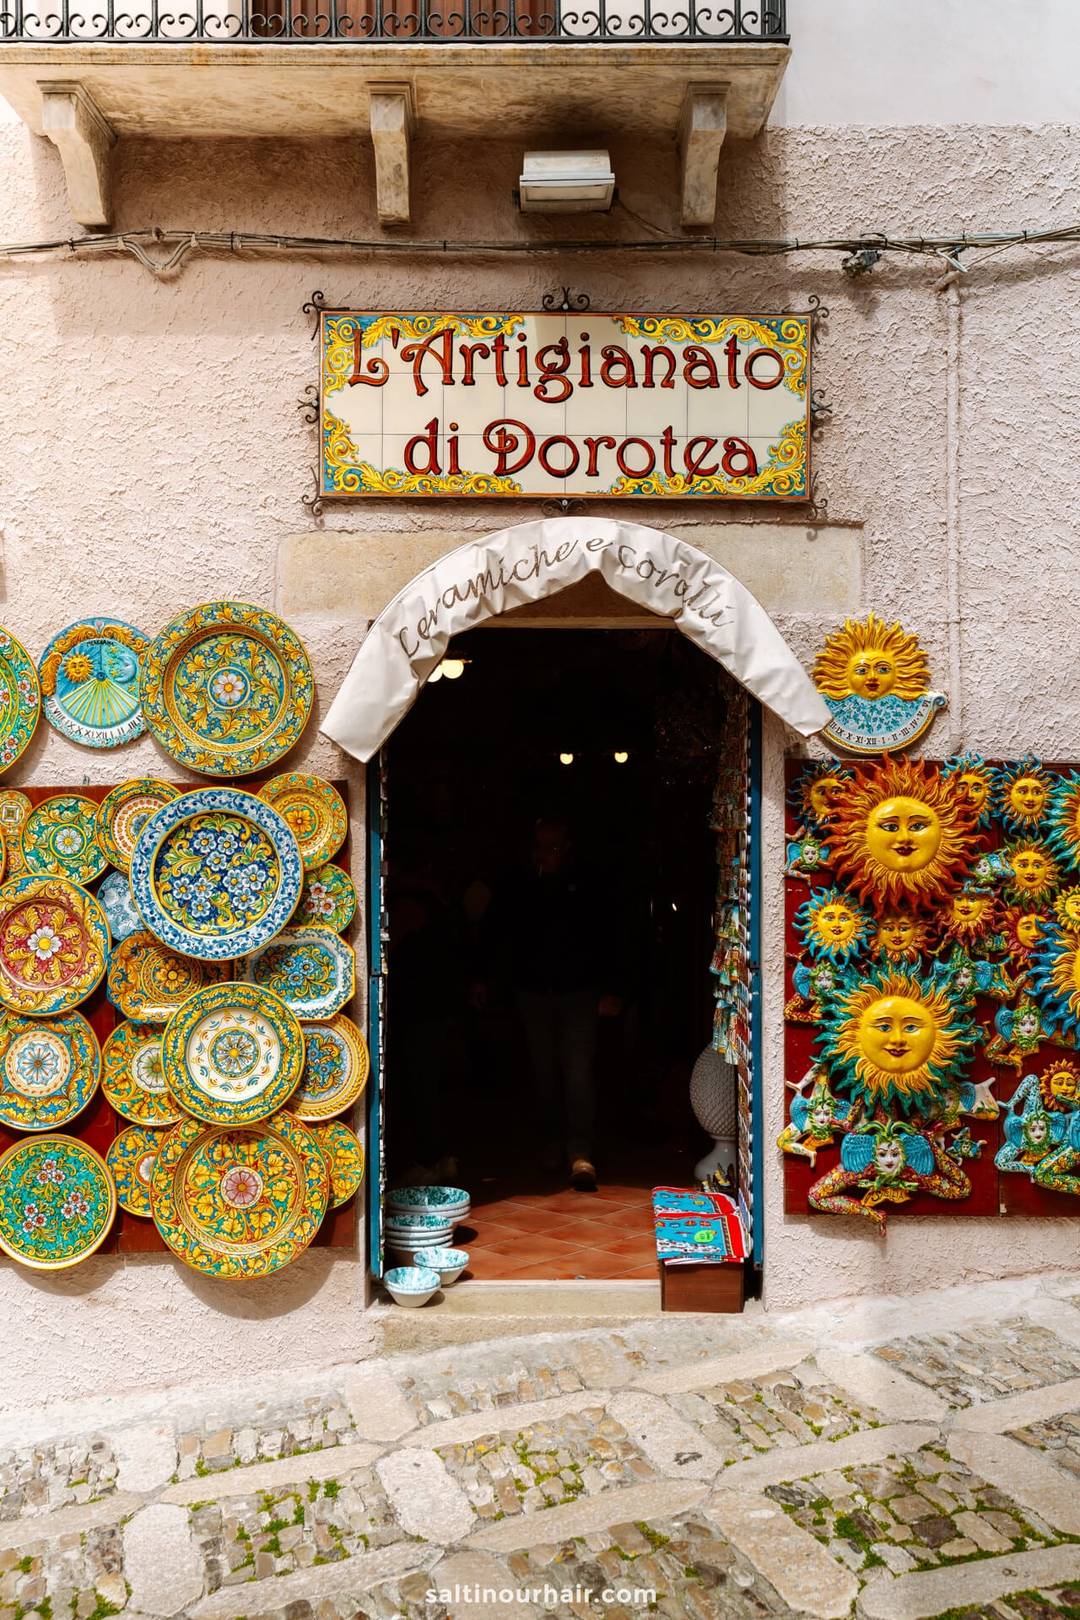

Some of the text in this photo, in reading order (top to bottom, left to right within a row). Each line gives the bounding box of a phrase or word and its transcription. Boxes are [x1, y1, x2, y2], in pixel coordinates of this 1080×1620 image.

[348, 328, 785, 403] L'Artigianato
[404, 417, 759, 484] di Dorotea
[399, 539, 579, 658] Ceramiche
[585, 537, 613, 552] e
[856, 735, 864, 743] XI
[866, 737, 877, 745] XII
